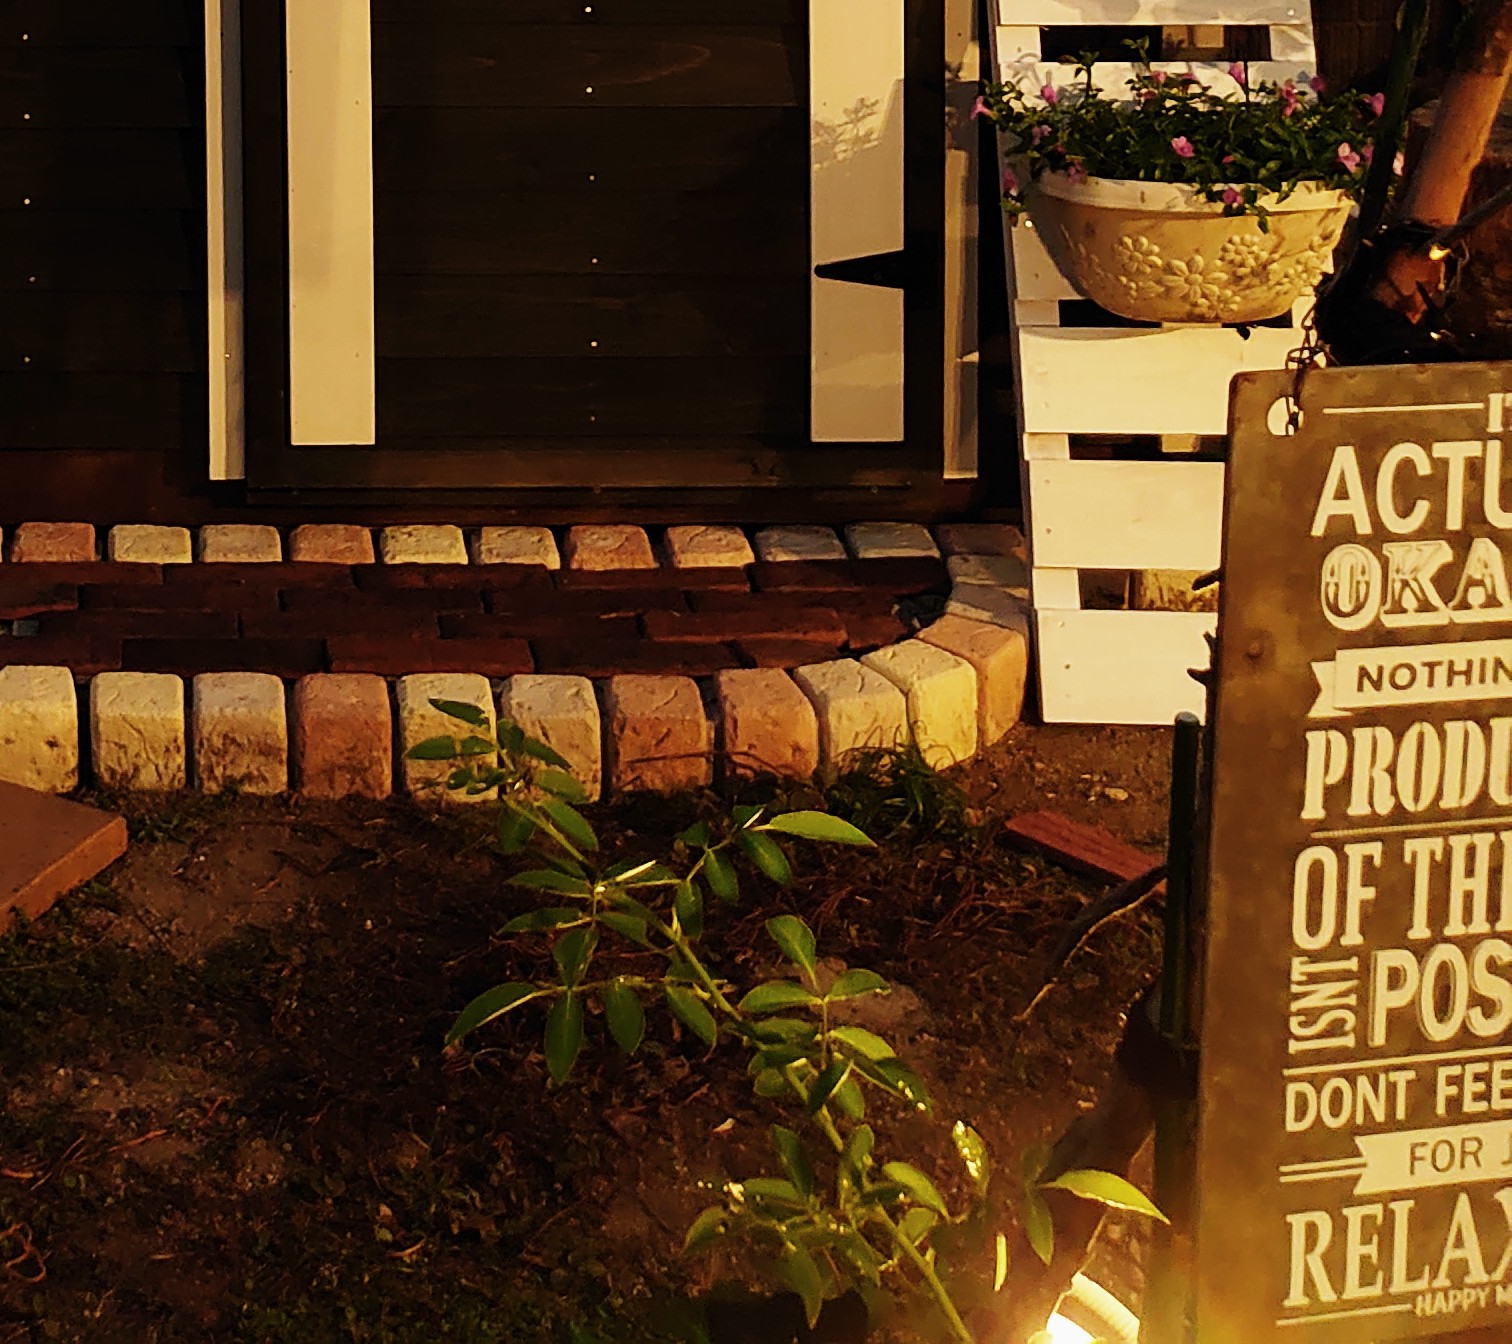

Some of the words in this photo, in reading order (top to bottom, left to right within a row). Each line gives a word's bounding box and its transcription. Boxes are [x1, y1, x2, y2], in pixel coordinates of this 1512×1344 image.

[1320, 537, 1512, 632] OKA
[1356, 656, 1512, 694] NOTHIN
[1291, 841, 1383, 951] OF
[1288, 955, 1361, 1055] ISNT
[1367, 938, 1512, 1049] POS
[1284, 1069, 1417, 1133] DONT
[1435, 1060, 1512, 1116] FEE
[1409, 1136, 1484, 1177] FOR
[1415, 1284, 1491, 1317] HAPPY
